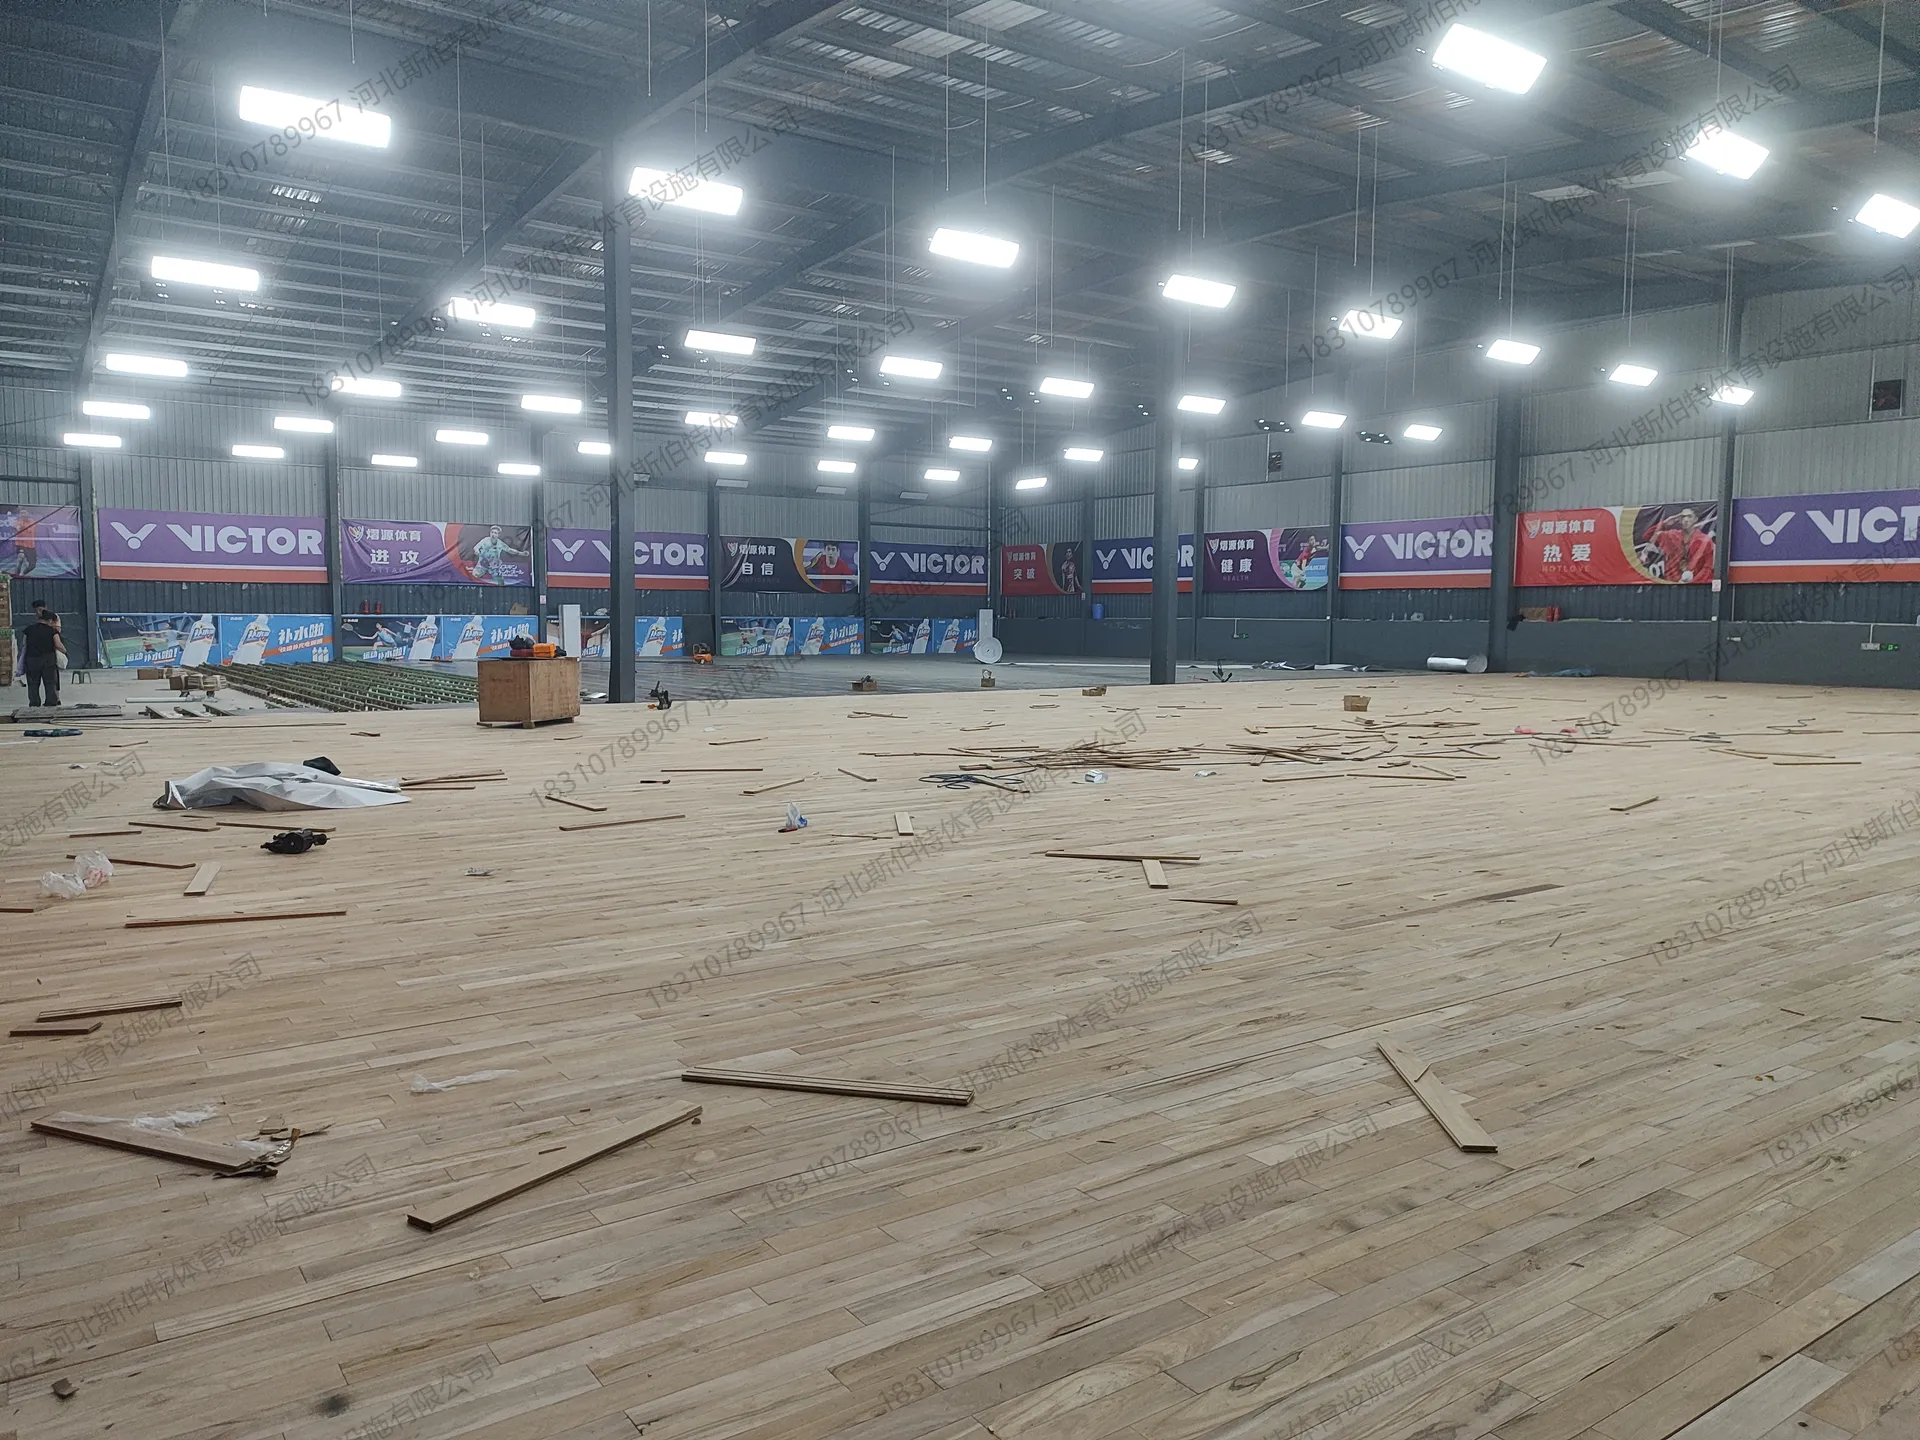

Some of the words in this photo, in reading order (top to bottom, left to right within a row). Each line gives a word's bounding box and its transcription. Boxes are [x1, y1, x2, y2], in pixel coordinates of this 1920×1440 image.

[166, 524, 323, 555] VICTOR
[1381, 529, 1493, 559] VICTOR
[592, 540, 705, 566] VCTOR
[900, 552, 985, 575] VICTOR
[1120, 545, 1194, 570] VICR
